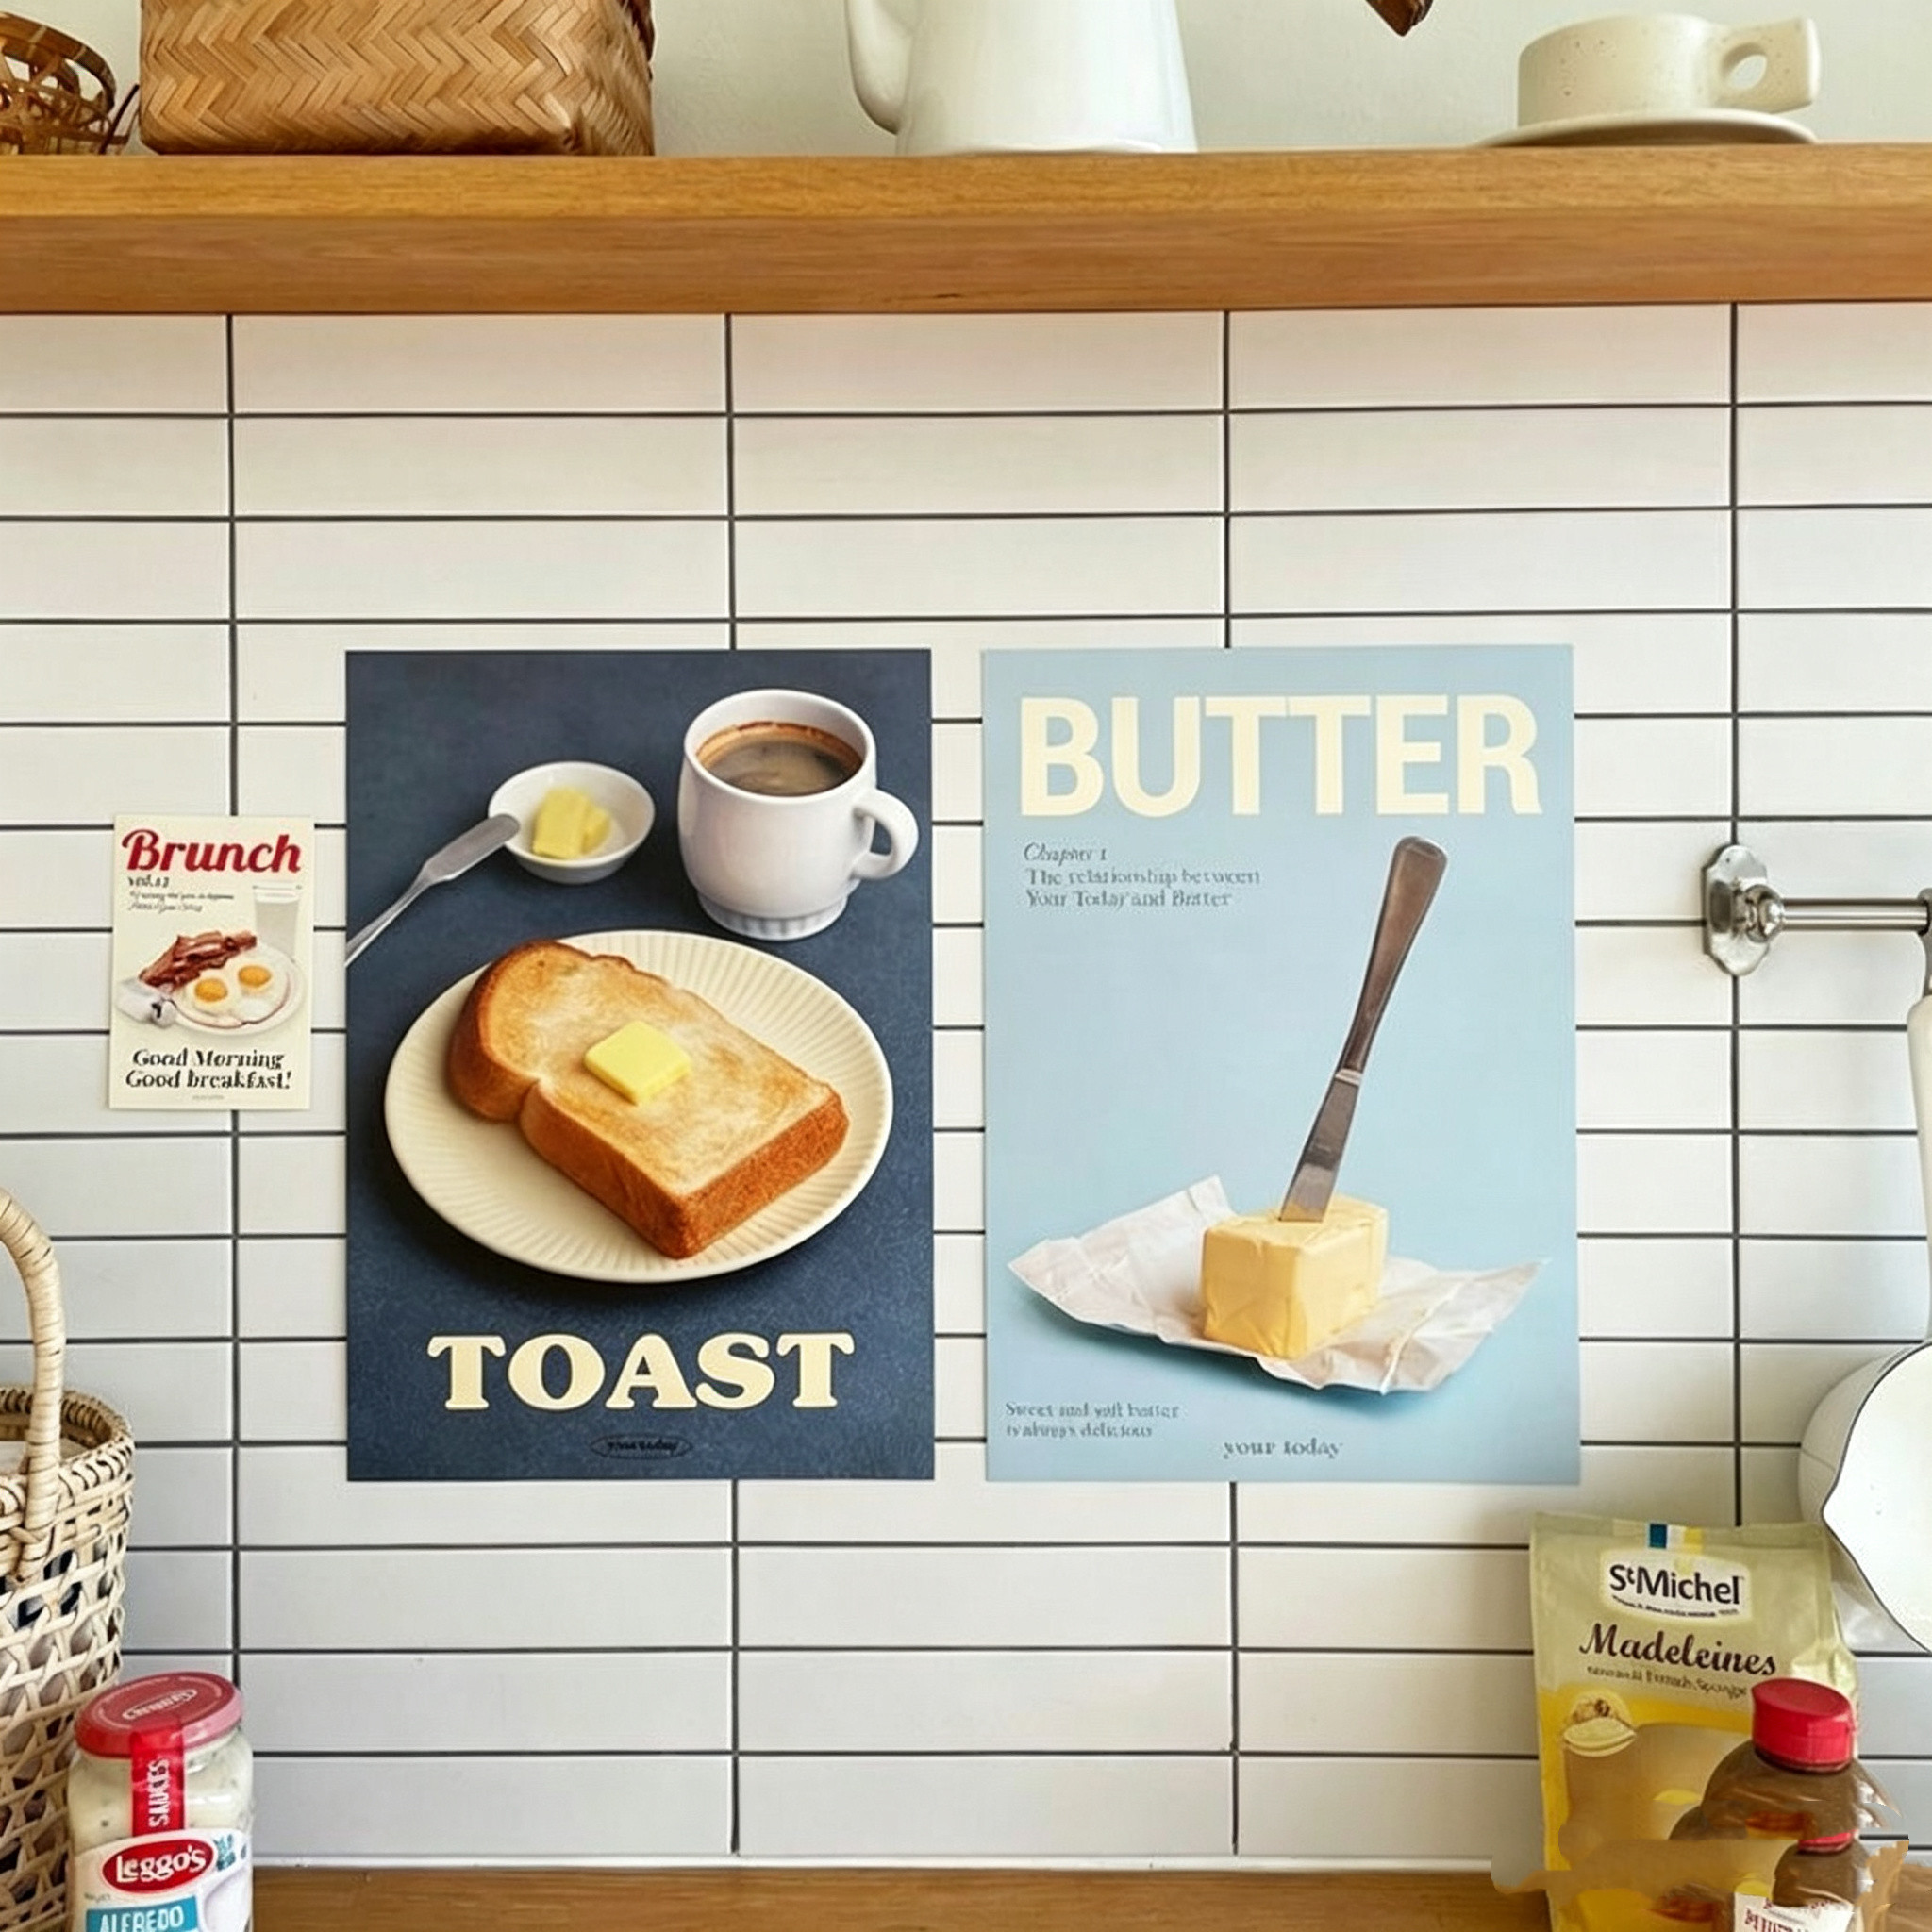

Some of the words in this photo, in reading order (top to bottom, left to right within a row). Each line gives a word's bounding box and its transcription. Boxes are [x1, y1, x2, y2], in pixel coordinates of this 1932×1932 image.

[1021, 694, 1542, 817] BUTTER
[122, 828, 302, 873] Brunch
[1027, 869, 1061, 886] The
[1073, 890, 1129, 910] Today
[1132, 889, 1165, 907] and
[132, 1047, 188, 1067] Good
[192, 1049, 285, 1070] Morning
[125, 1069, 181, 1088] Good
[187, 1069, 291, 1090] breakfast!
[427, 1332, 856, 1410] TOAST
[1224, 1442, 1276, 1459] your
[1284, 1437, 1342, 1459] today
[1579, 1623, 1777, 1676] Madeleines
[149, 1757, 171, 1827] SAUCES
[116, 1844, 207, 1883] Leggo's
[99, 1905, 185, 1932] ALFREDO
